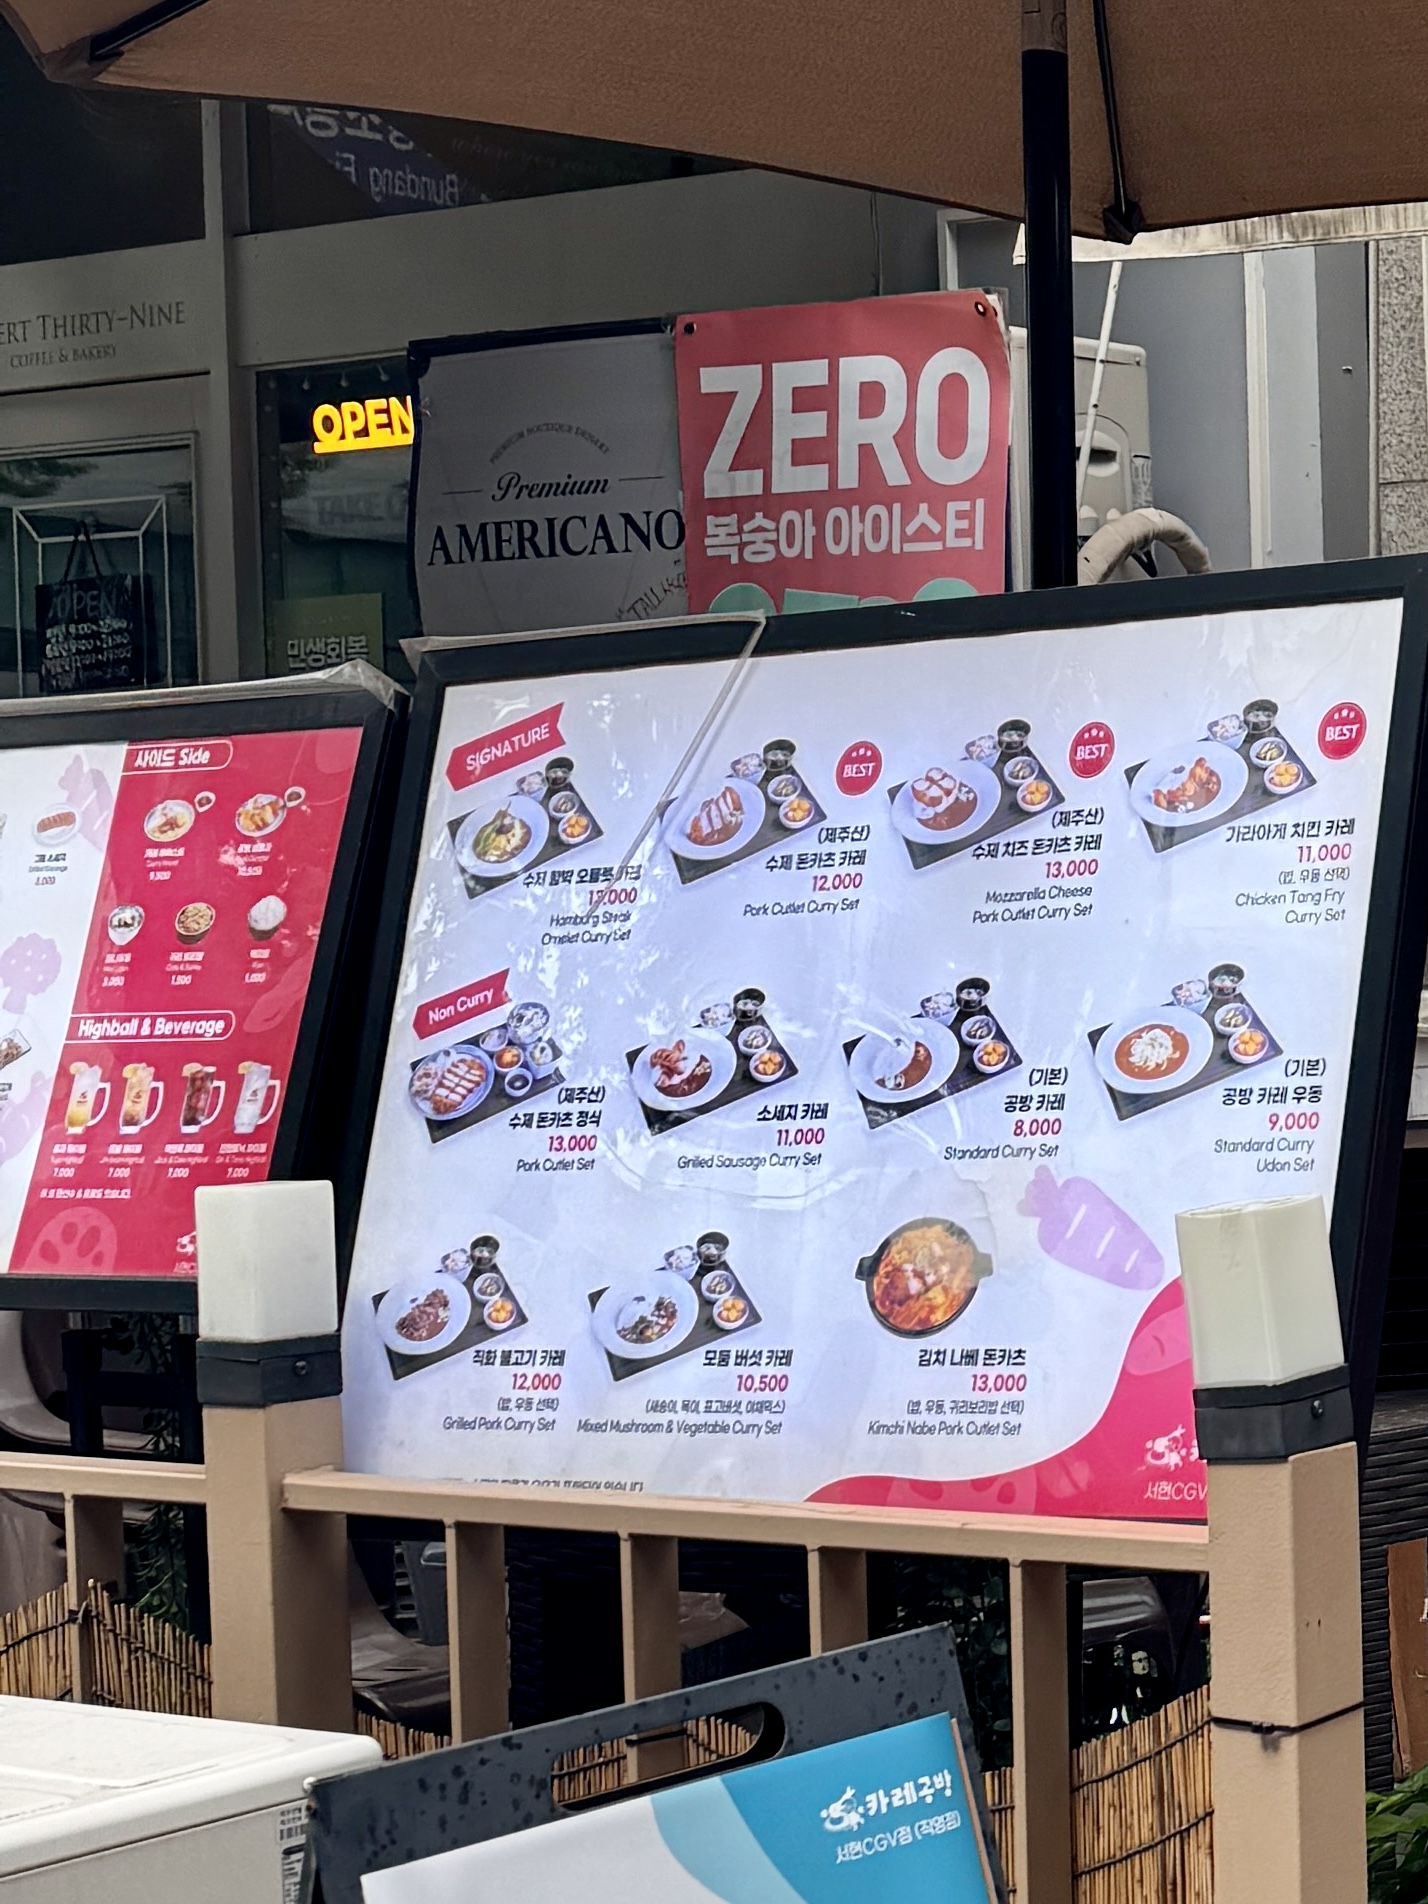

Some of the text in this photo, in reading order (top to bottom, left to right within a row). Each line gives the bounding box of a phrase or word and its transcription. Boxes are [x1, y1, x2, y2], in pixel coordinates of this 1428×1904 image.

[36, 300, 186, 341] THIRTY-NINE
[312, 396, 414, 444] OPEN
[698, 346, 992, 499] ZERO
[489, 470, 610, 503] Premium
[427, 507, 686, 568] AMERICANO
[705, 498, 985, 563] 복숭아 아이스티
[1325, 724, 1360, 741] BEST
[178, 746, 210, 766] Side
[466, 724, 550, 771] SIGNATURE
[1075, 745, 1108, 760] BEST
[843, 763, 876, 778] BEST
[1226, 823, 1286, 843] 가라아게
[1324, 817, 1355, 837] 카레
[1297, 843, 1352, 864] 11,000
[1045, 858, 1099, 878] 13,000
[812, 873, 863, 892] 12,000
[1324, 888, 1345, 904] Fry
[1285, 909, 1322, 925] Curry
[428, 988, 494, 1025] Non Curry
[78, 1017, 225, 1039] Highball & Beverage
[1029, 1067, 1068, 1087] (기본)
[1285, 1058, 1326, 1078] (기본)
[1004, 1094, 1066, 1113] 공방 카레
[1222, 1088, 1253, 1106] 공방
[1256, 1087, 1289, 1105] 카레
[509, 1112, 534, 1130] 수제
[800, 1103, 829, 1120] 카레
[1013, 1118, 1062, 1137] 8,000
[1268, 1112, 1320, 1132] 9,000
[548, 1135, 597, 1153] 13,000
[776, 1128, 825, 1146] 11,000
[1214, 1137, 1315, 1154] Standard Curry
[944, 1144, 1059, 1161] Standard Curry Set
[1293, 1157, 1315, 1172] Set
[734, 1349, 763, 1368] 버섯
[765, 1349, 793, 1367] 카레
[918, 1348, 1027, 1368] 김치 나베 돈카츠
[511, 1373, 562, 1392] 12,000
[736, 1374, 790, 1393] 10,500
[970, 1374, 1027, 1393] 13,000
[537, 1416, 556, 1431] Set
[665, 1420, 674, 1434] &
[732, 1419, 763, 1438] Curry
[764, 1419, 783, 1435] Set
[867, 1421, 906, 1436] Kimchi
[1002, 1421, 1022, 1436] Set
[865, 1769, 953, 1816] 카레공방
